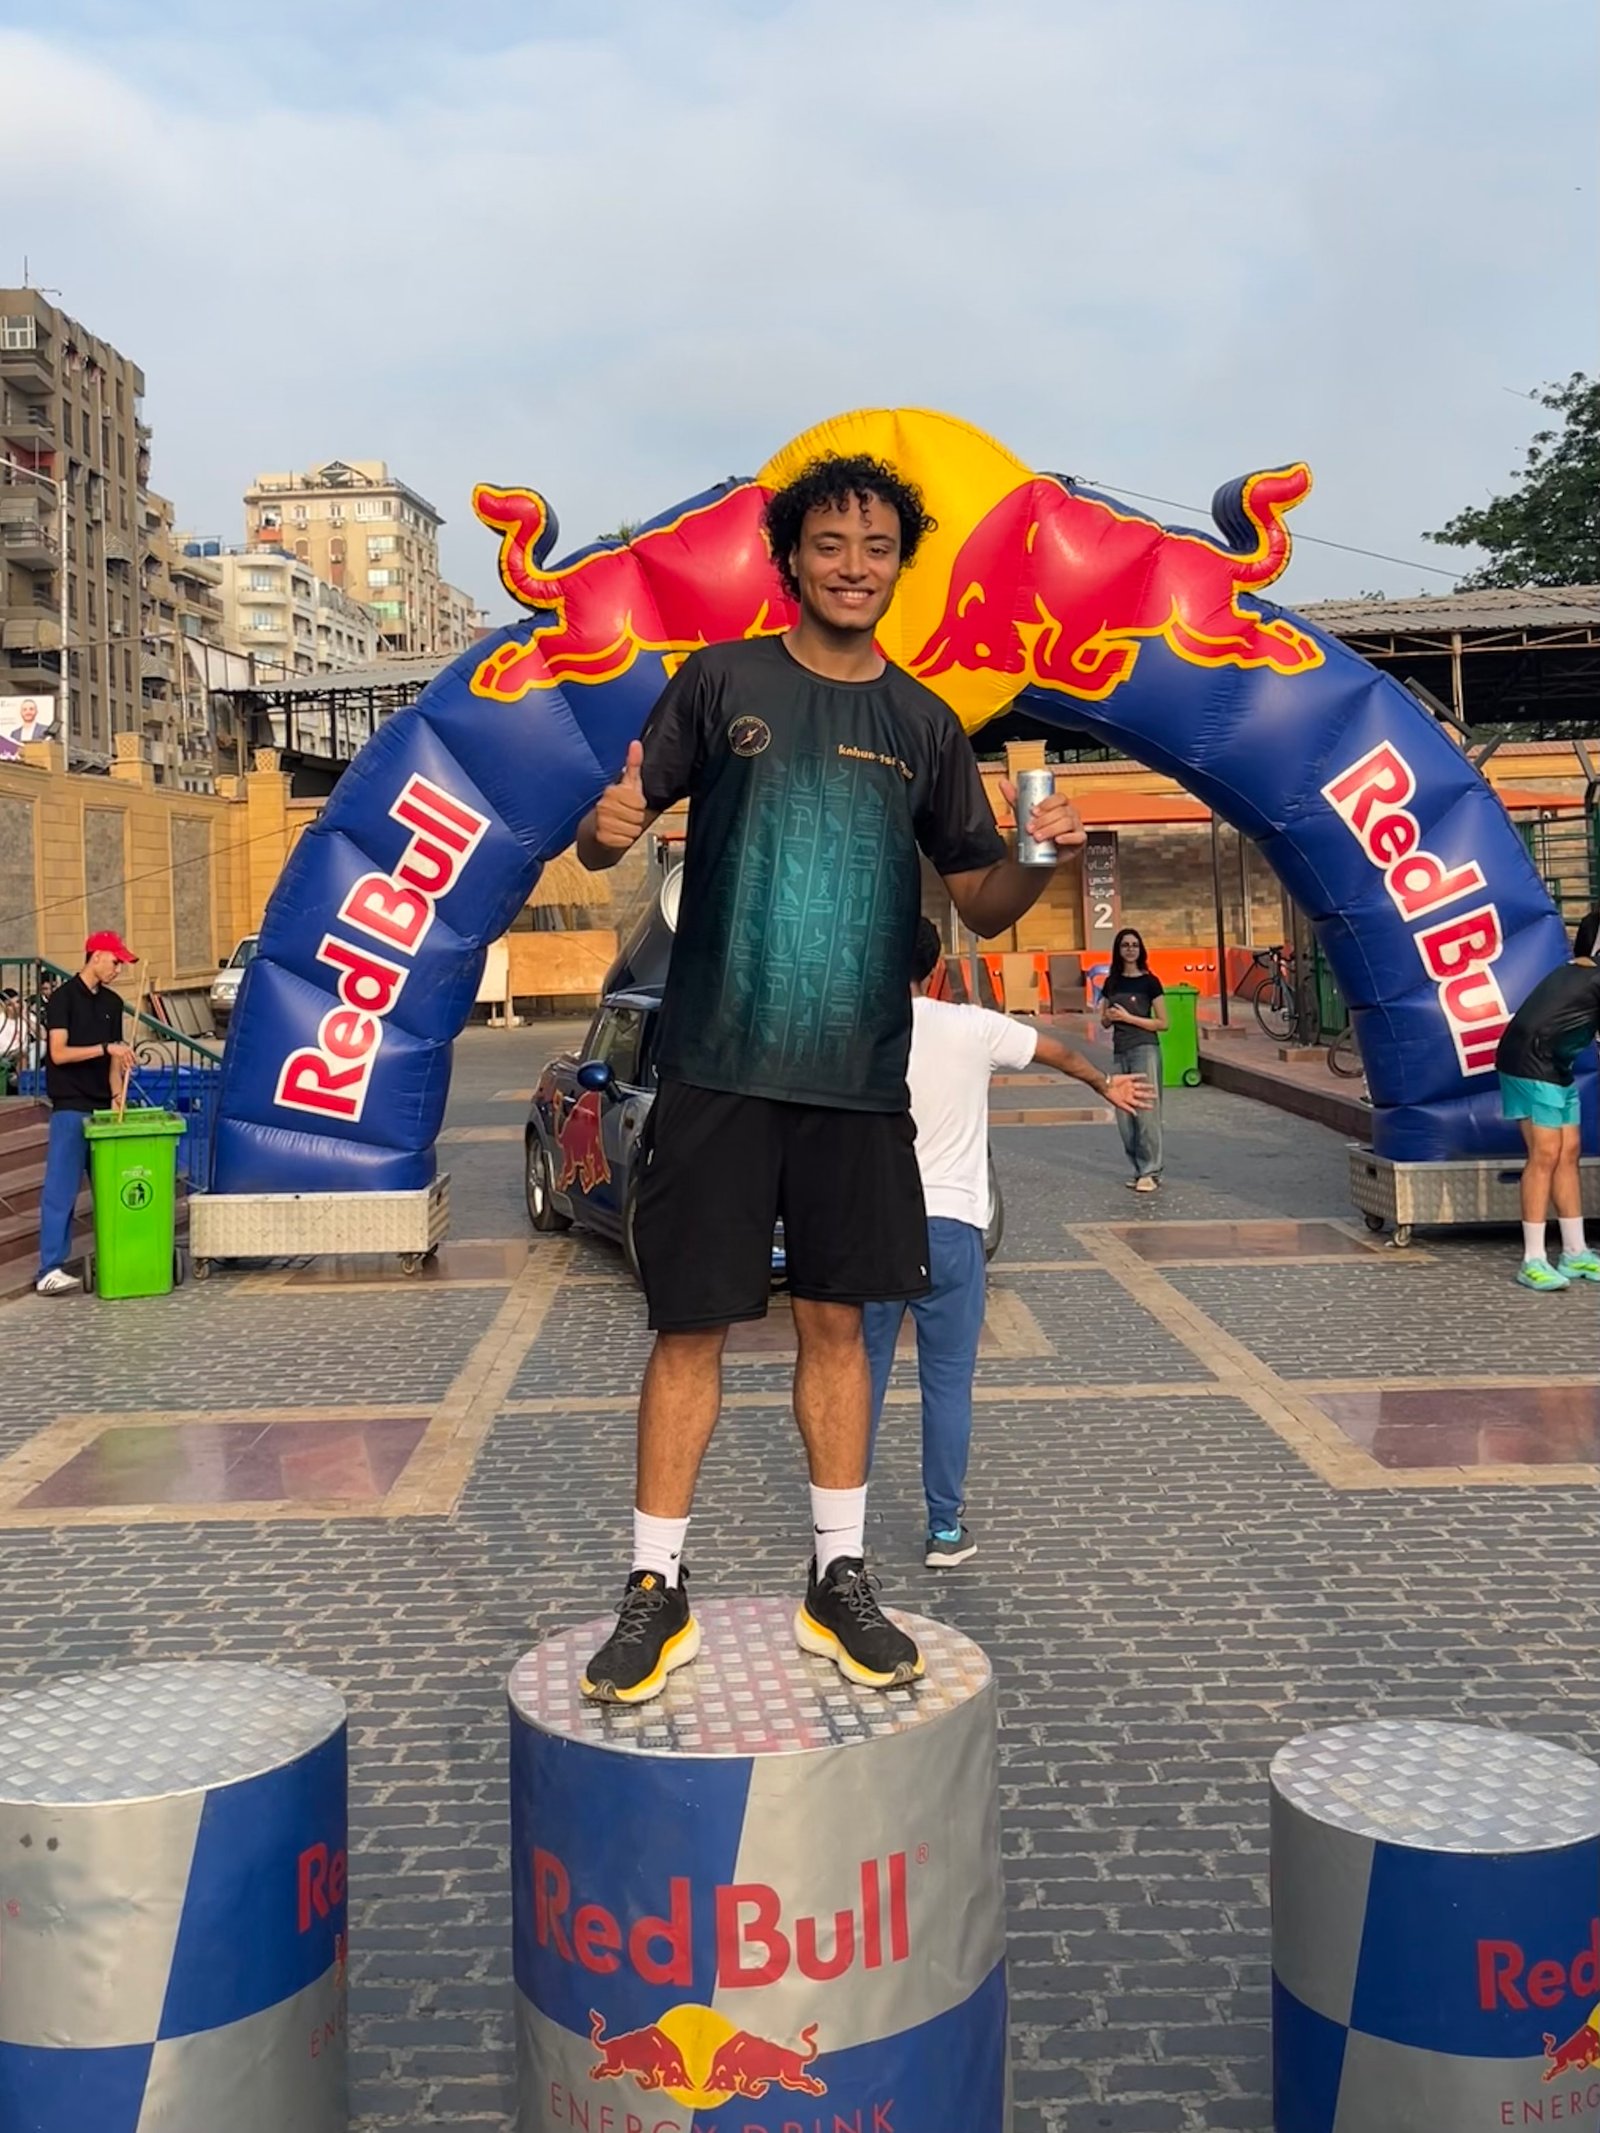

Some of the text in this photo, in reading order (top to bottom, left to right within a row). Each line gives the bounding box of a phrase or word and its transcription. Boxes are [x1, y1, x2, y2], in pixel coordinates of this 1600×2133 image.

[1327, 746, 1482, 916] Red
[279, 778, 484, 1117] Red Bull
[1094, 903, 1113, 929] 2
[297, 1841, 347, 1934] Re
[531, 1846, 911, 1990] Red Bull
[1477, 1916, 1600, 2011] Red
